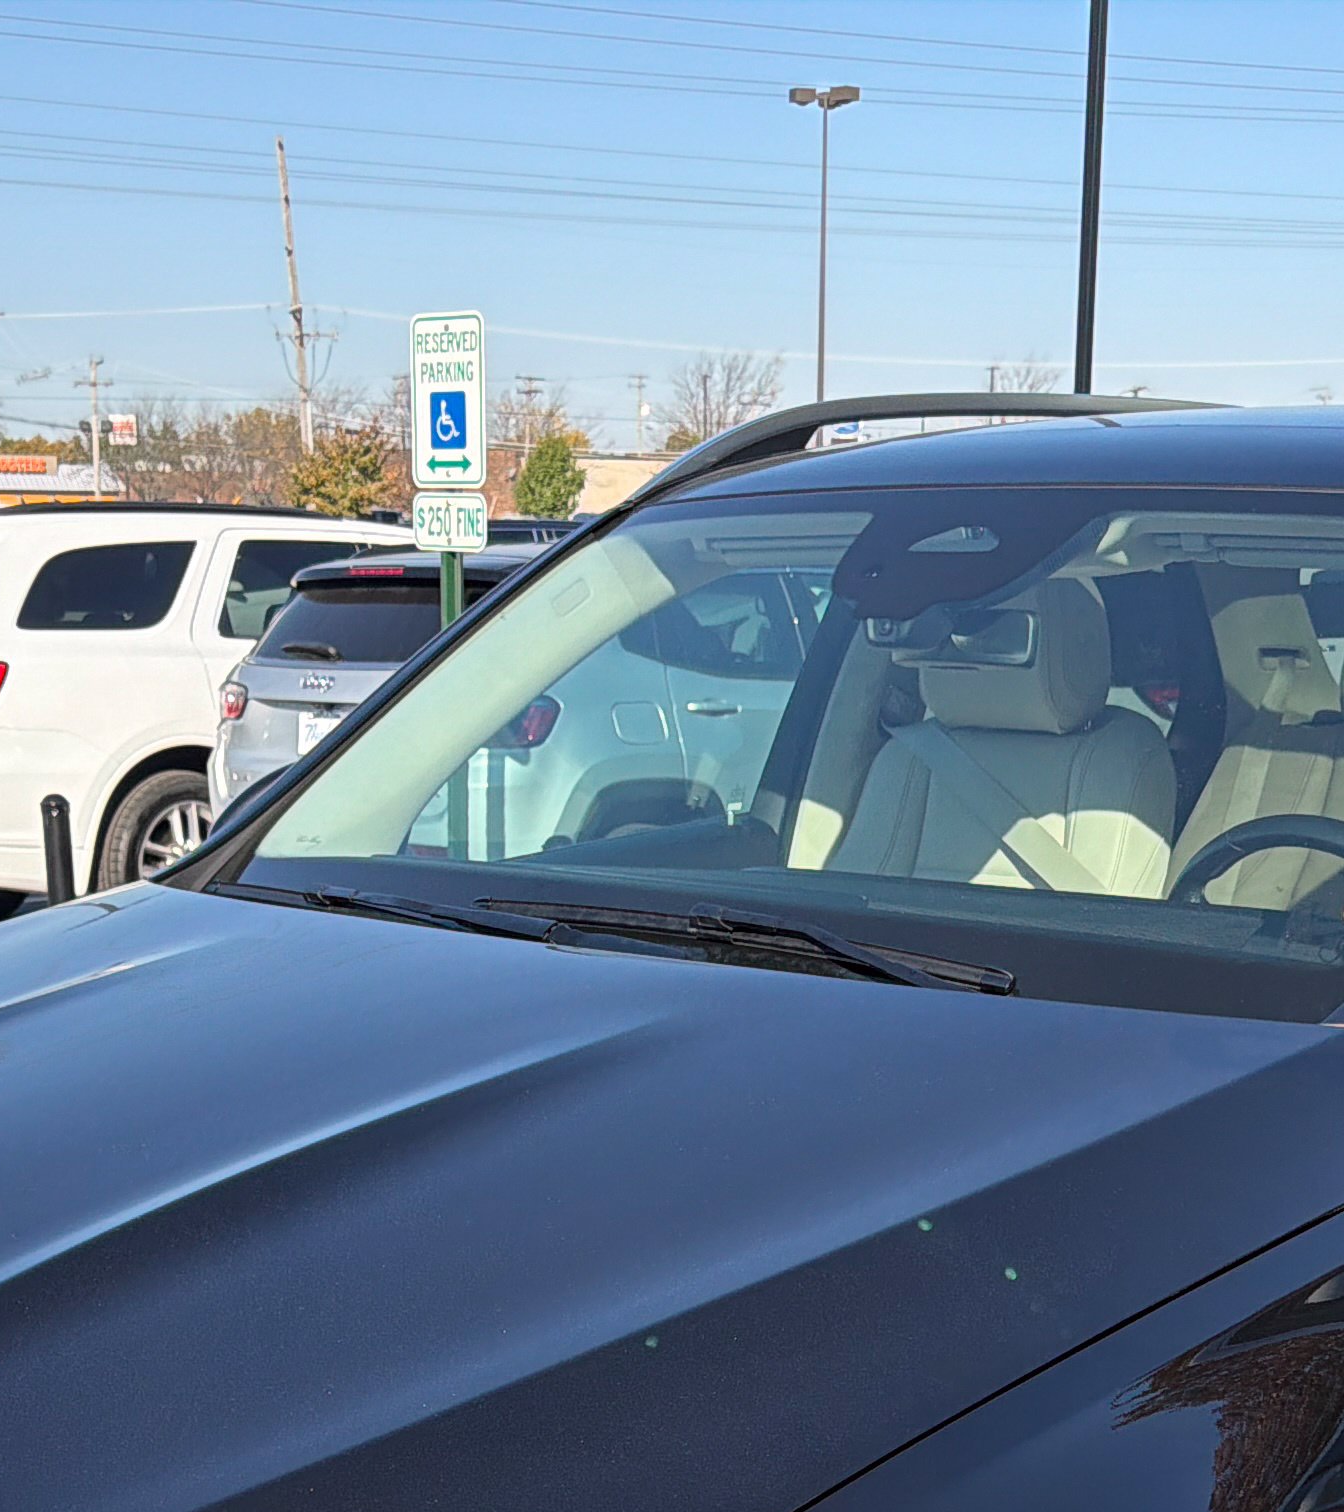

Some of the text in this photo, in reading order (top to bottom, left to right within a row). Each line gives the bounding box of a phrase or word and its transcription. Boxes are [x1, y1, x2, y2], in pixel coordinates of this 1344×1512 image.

[416, 331, 478, 354] RESERVED
[420, 361, 474, 383] PARKING
[456, 507, 484, 538] FINE
